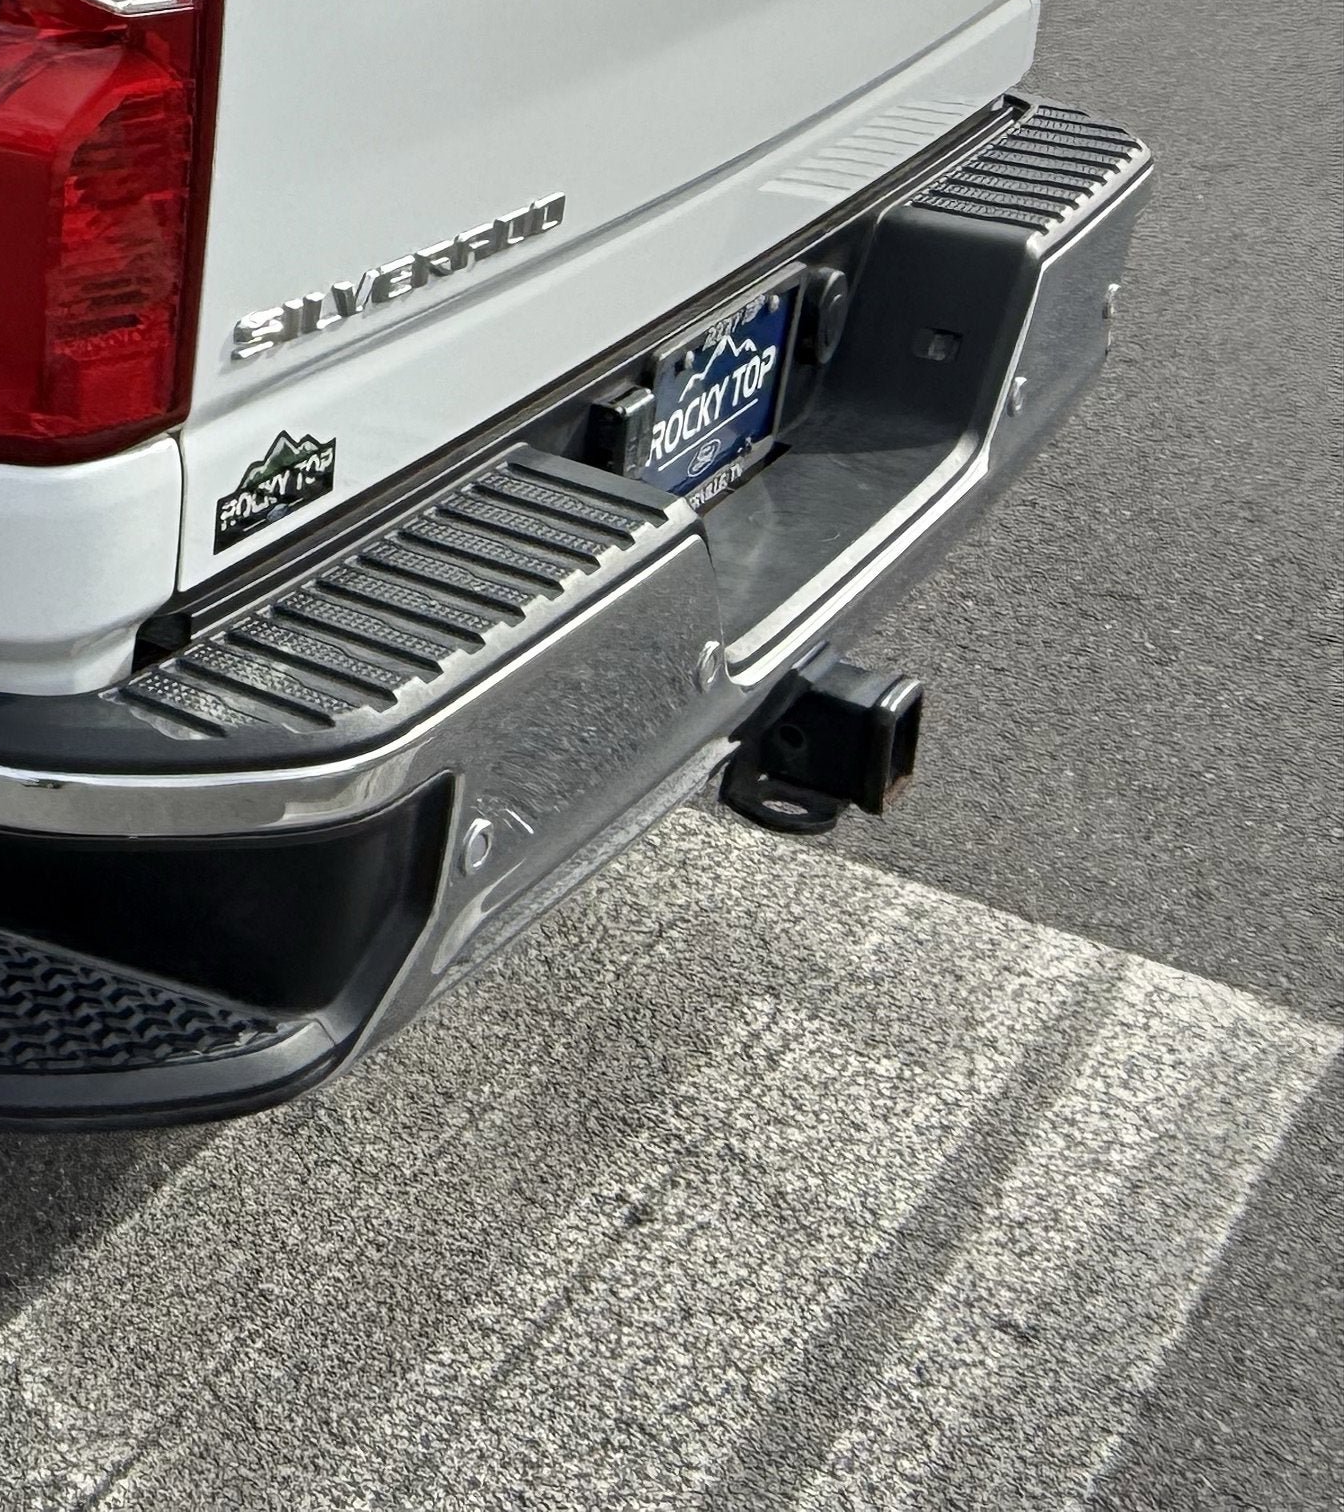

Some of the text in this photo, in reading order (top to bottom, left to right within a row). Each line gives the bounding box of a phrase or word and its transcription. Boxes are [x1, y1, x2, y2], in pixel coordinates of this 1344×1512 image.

[645, 376, 730, 468] ROCKY
[732, 344, 777, 407] TOP
[220, 447, 334, 532] ROCKY TOP
